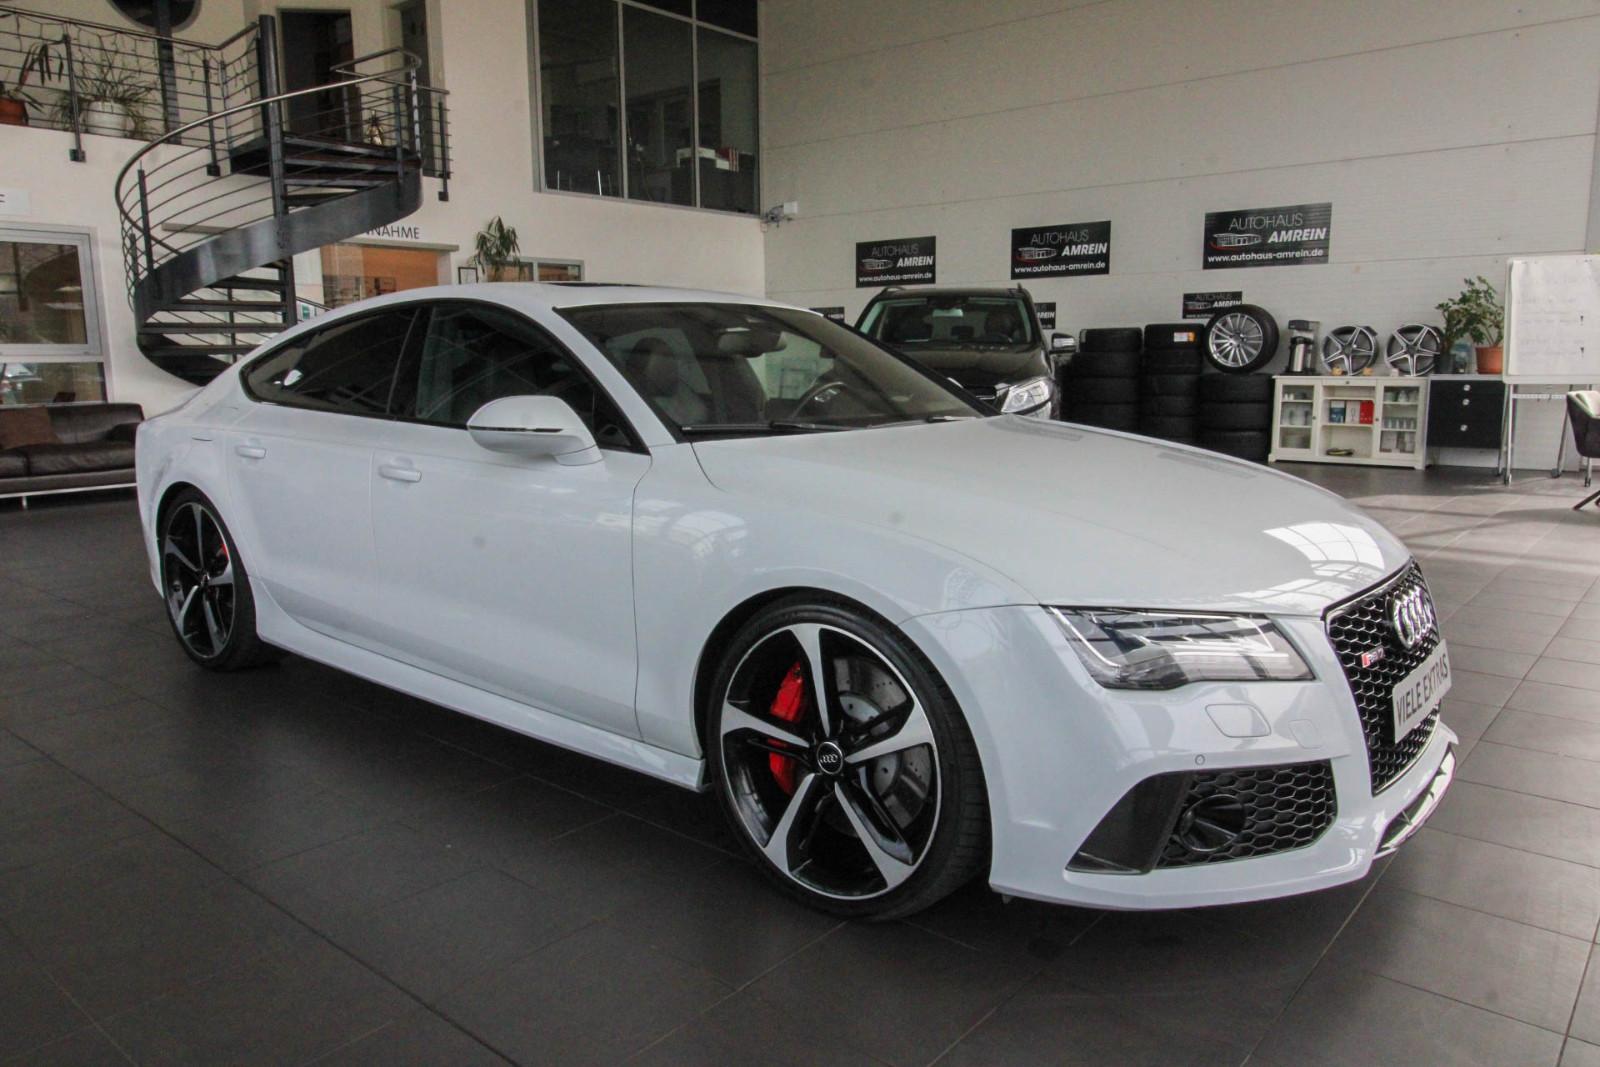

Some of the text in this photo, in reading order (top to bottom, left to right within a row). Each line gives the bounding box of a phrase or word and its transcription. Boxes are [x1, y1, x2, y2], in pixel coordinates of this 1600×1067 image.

[1229, 212, 1303, 231] AUTOHAUS
[366, 225, 420, 239] NAHME
[1031, 229, 1089, 246] AUTOHAUS
[1267, 228, 1327, 244] AMREIN
[872, 243, 919, 257] AUTOHAUS
[1061, 242, 1108, 257] AMREIN
[1208, 249, 1324, 263] www.autohaus-amrein.de
[897, 256, 934, 268] AMREIN
[1014, 261, 1106, 274] www.autohaus-amrein.de
[858, 272, 933, 282] www.autohaus-amrein.de
[1396, 653, 1448, 726] VIELE EXTRAS
